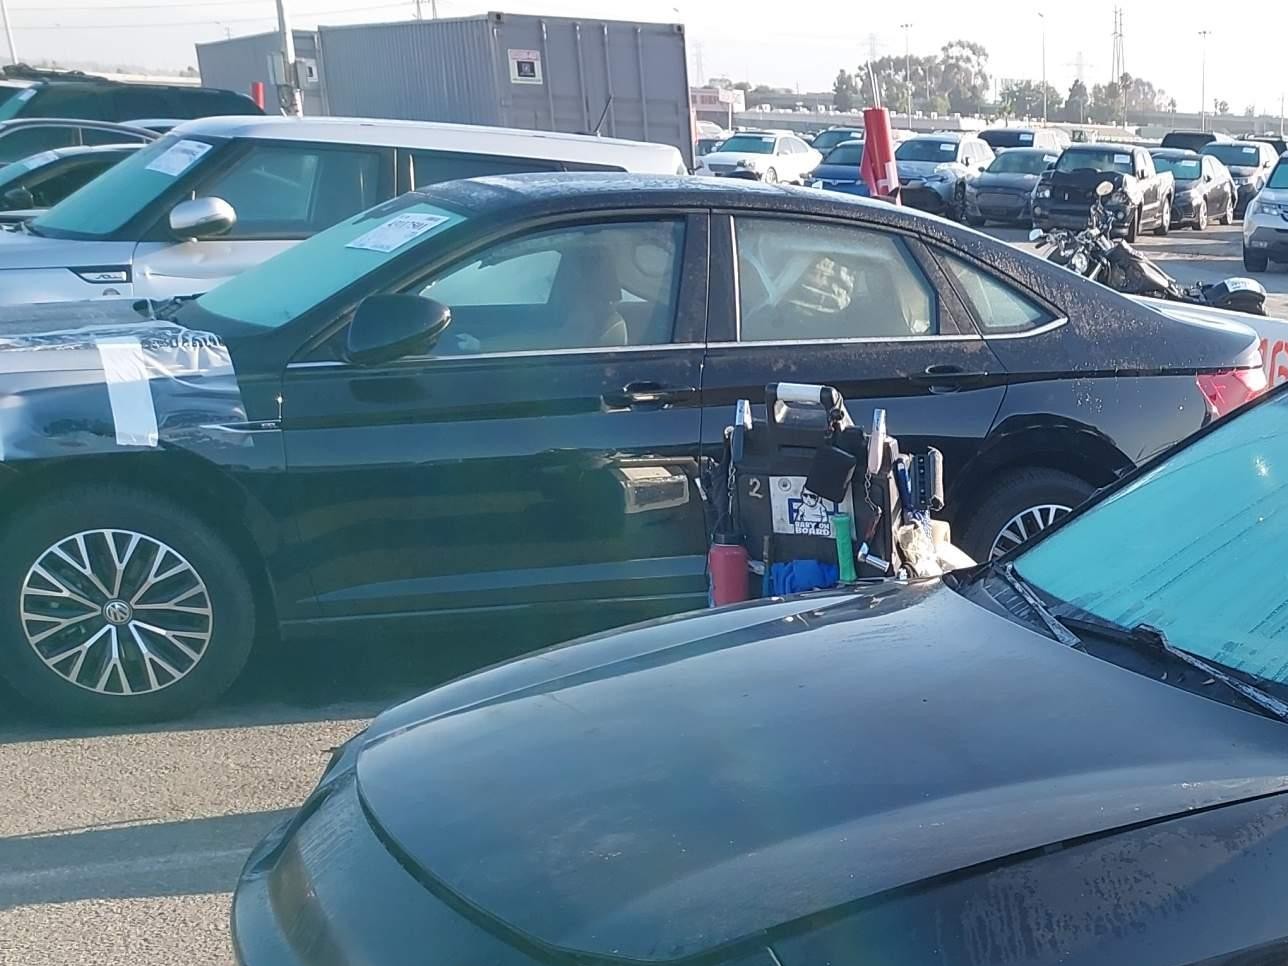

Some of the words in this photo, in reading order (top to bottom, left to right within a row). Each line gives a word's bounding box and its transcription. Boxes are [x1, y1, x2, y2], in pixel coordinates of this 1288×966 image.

[749, 478, 763, 499] 2
[818, 522, 830, 530] ON
[795, 528, 830, 536] BOARD
